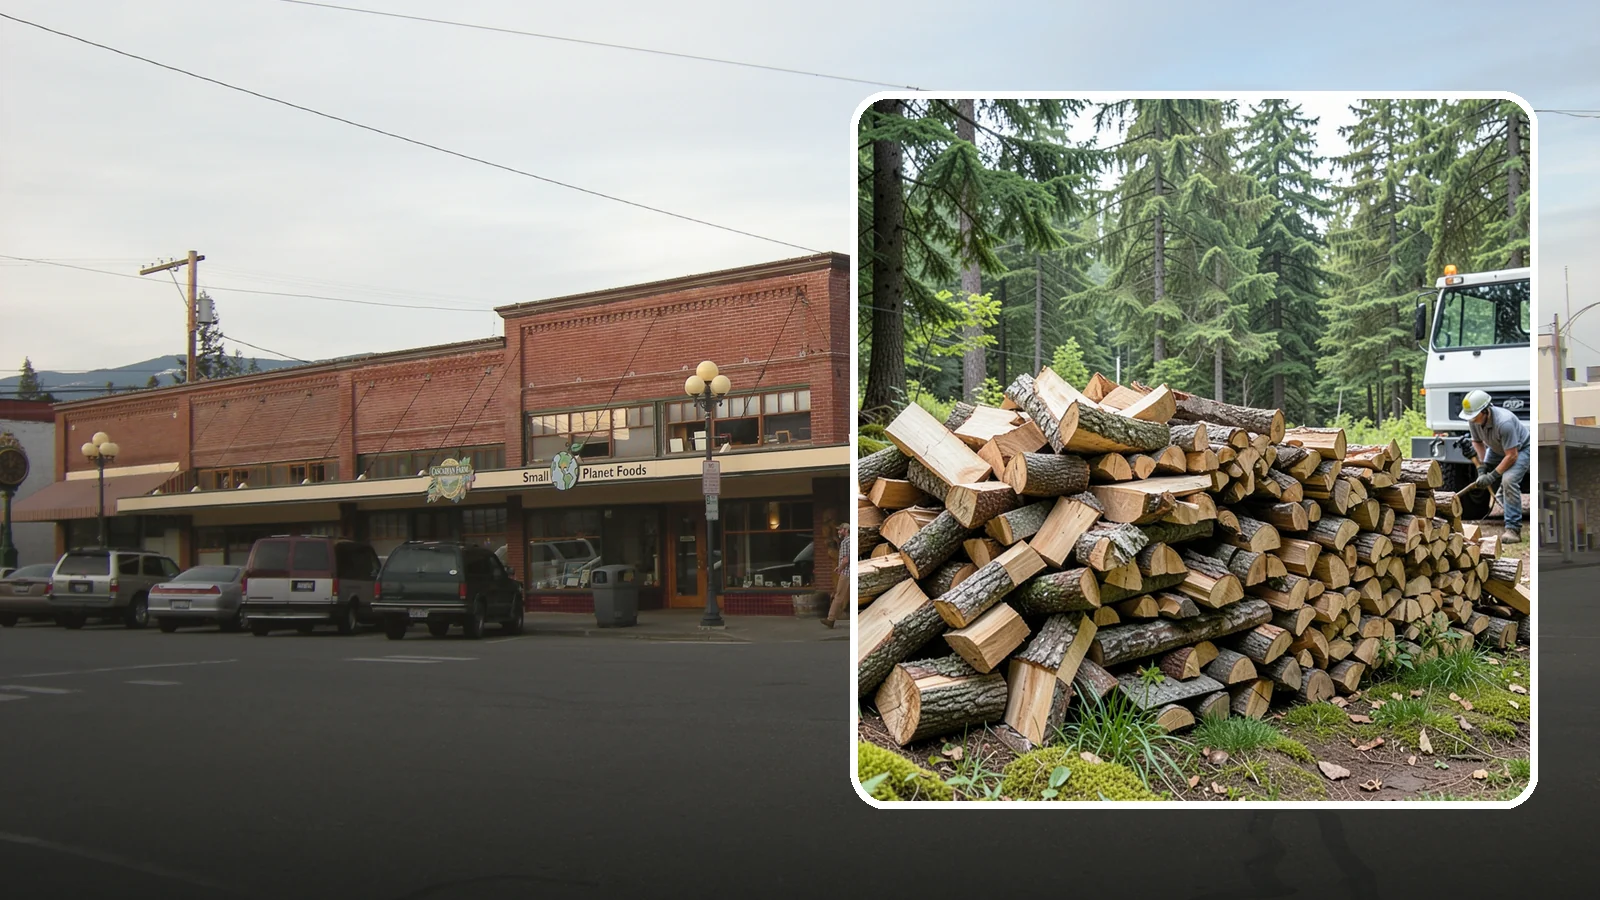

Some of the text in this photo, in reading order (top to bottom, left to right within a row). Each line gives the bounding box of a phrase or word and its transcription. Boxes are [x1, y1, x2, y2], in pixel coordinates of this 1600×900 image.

[523, 464, 647, 483] Small Planet Foods
